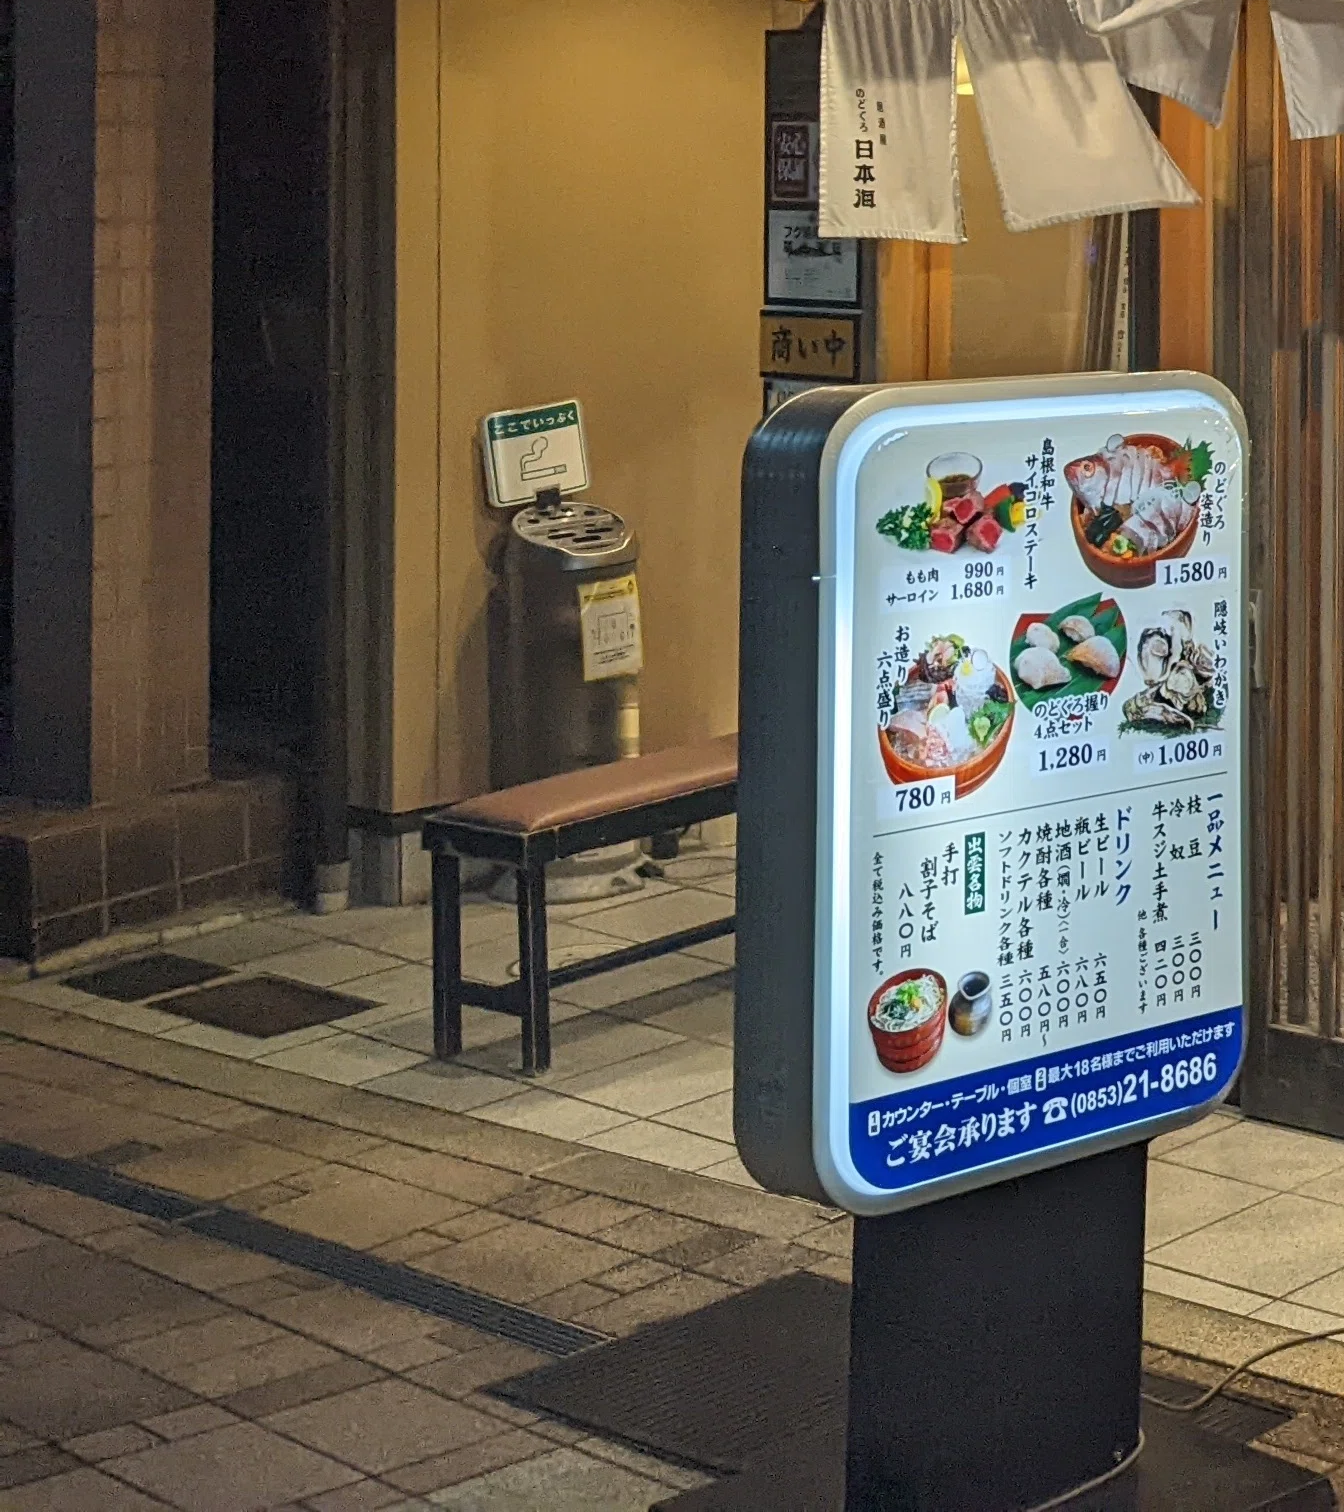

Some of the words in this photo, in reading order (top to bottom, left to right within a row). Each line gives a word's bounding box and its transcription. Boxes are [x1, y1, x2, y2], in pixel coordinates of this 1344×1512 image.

[853, 138, 876, 208] 日本海
[771, 327, 846, 365] 商い中
[494, 410, 575, 436] ここでいっぷく
[1040, 437, 1055, 511] 島根和牛
[1214, 461, 1227, 530] のどぐろ
[1024, 454, 1039, 589] サイコロステーキ
[1199, 493, 1214, 546] 姿造り
[886, 589, 939, 606] サーロイン
[906, 567, 939, 585] もも肉
[876, 651, 893, 728] 六点盛り
[894, 625, 910, 682] お造り
[1213, 599, 1228, 706] 隠岐いわがき
[1034, 693, 1109, 719] のどぐろ握り
[1034, 715, 1093, 739] 4点セット
[941, 841, 959, 886] 手打
[966, 836, 983, 910] 出雲名物
[1036, 822, 1053, 912] 焼酎各種
[1074, 816, 1090, 902] 瓶ビール
[1094, 813, 1109, 898] 生ビール
[1115, 805, 1132, 907] ドリンク
[1152, 800, 1168, 924] 牛スジ土手煮
[1207, 793, 1224, 930] 一品メニュー
[920, 856, 938, 943] 割子そば
[997, 829, 1014, 967] ソフトドリンク各種
[1017, 828, 1034, 961] カクテル各種
[886, 1100, 1038, 1168] ご宴会承ります
